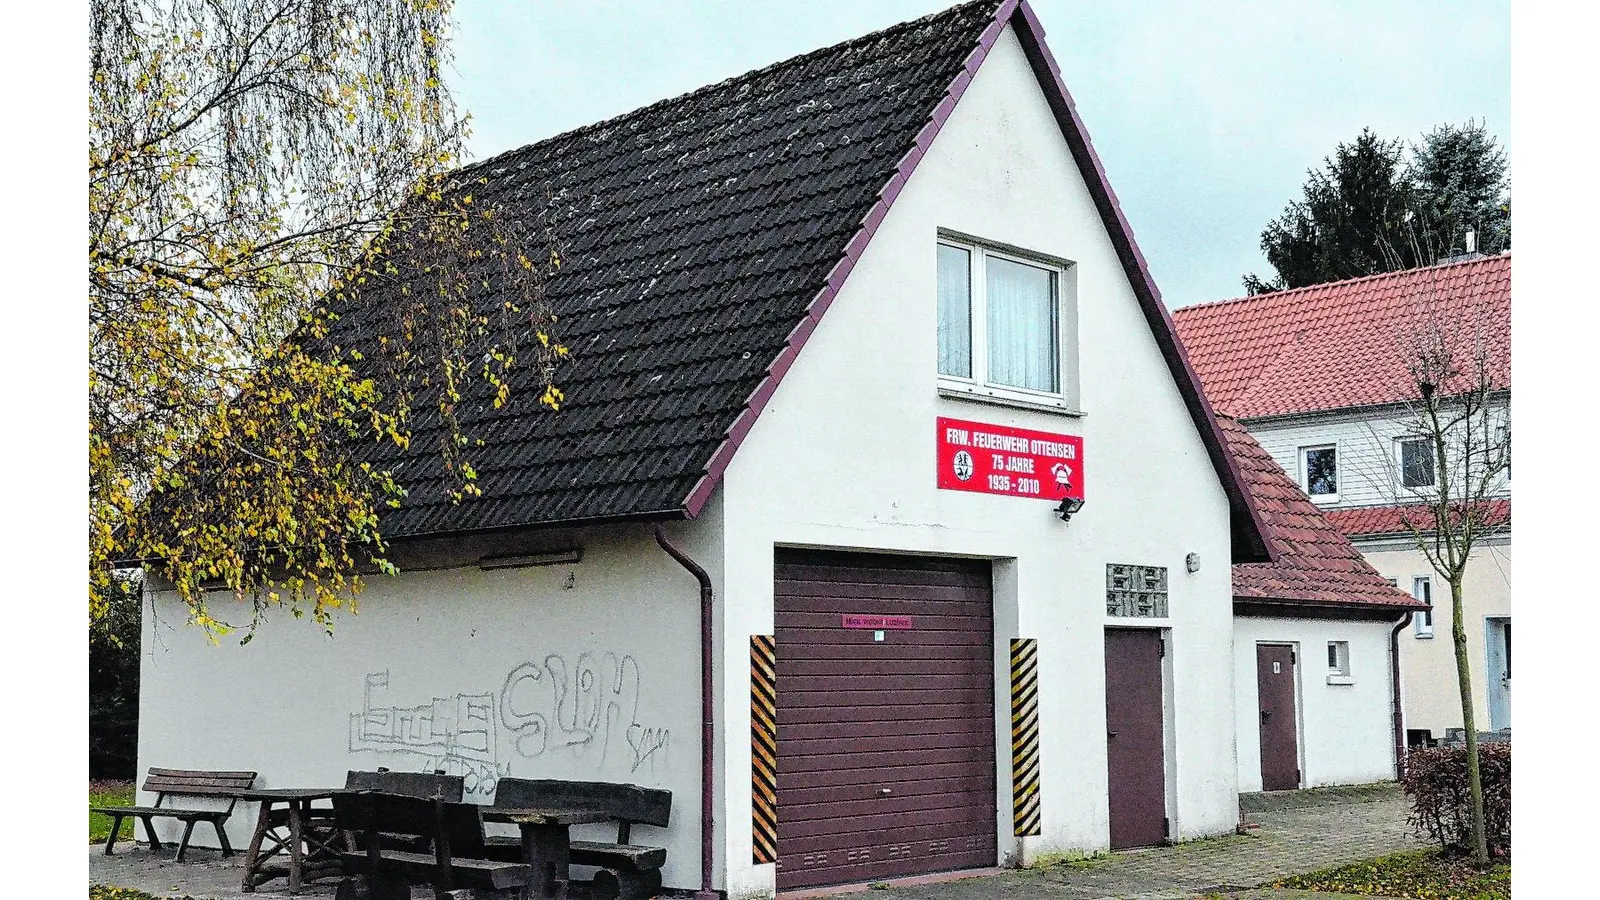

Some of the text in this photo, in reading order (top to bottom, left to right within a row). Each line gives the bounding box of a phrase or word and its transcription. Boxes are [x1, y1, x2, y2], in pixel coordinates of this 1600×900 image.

[946, 428, 1075, 459] FRW. FEUERWEHR OTTENSEN
[991, 454, 1035, 474] 75 JAHRE
[987, 474, 1010, 491] 1935
[1018, 478, 1040, 495] 2010
